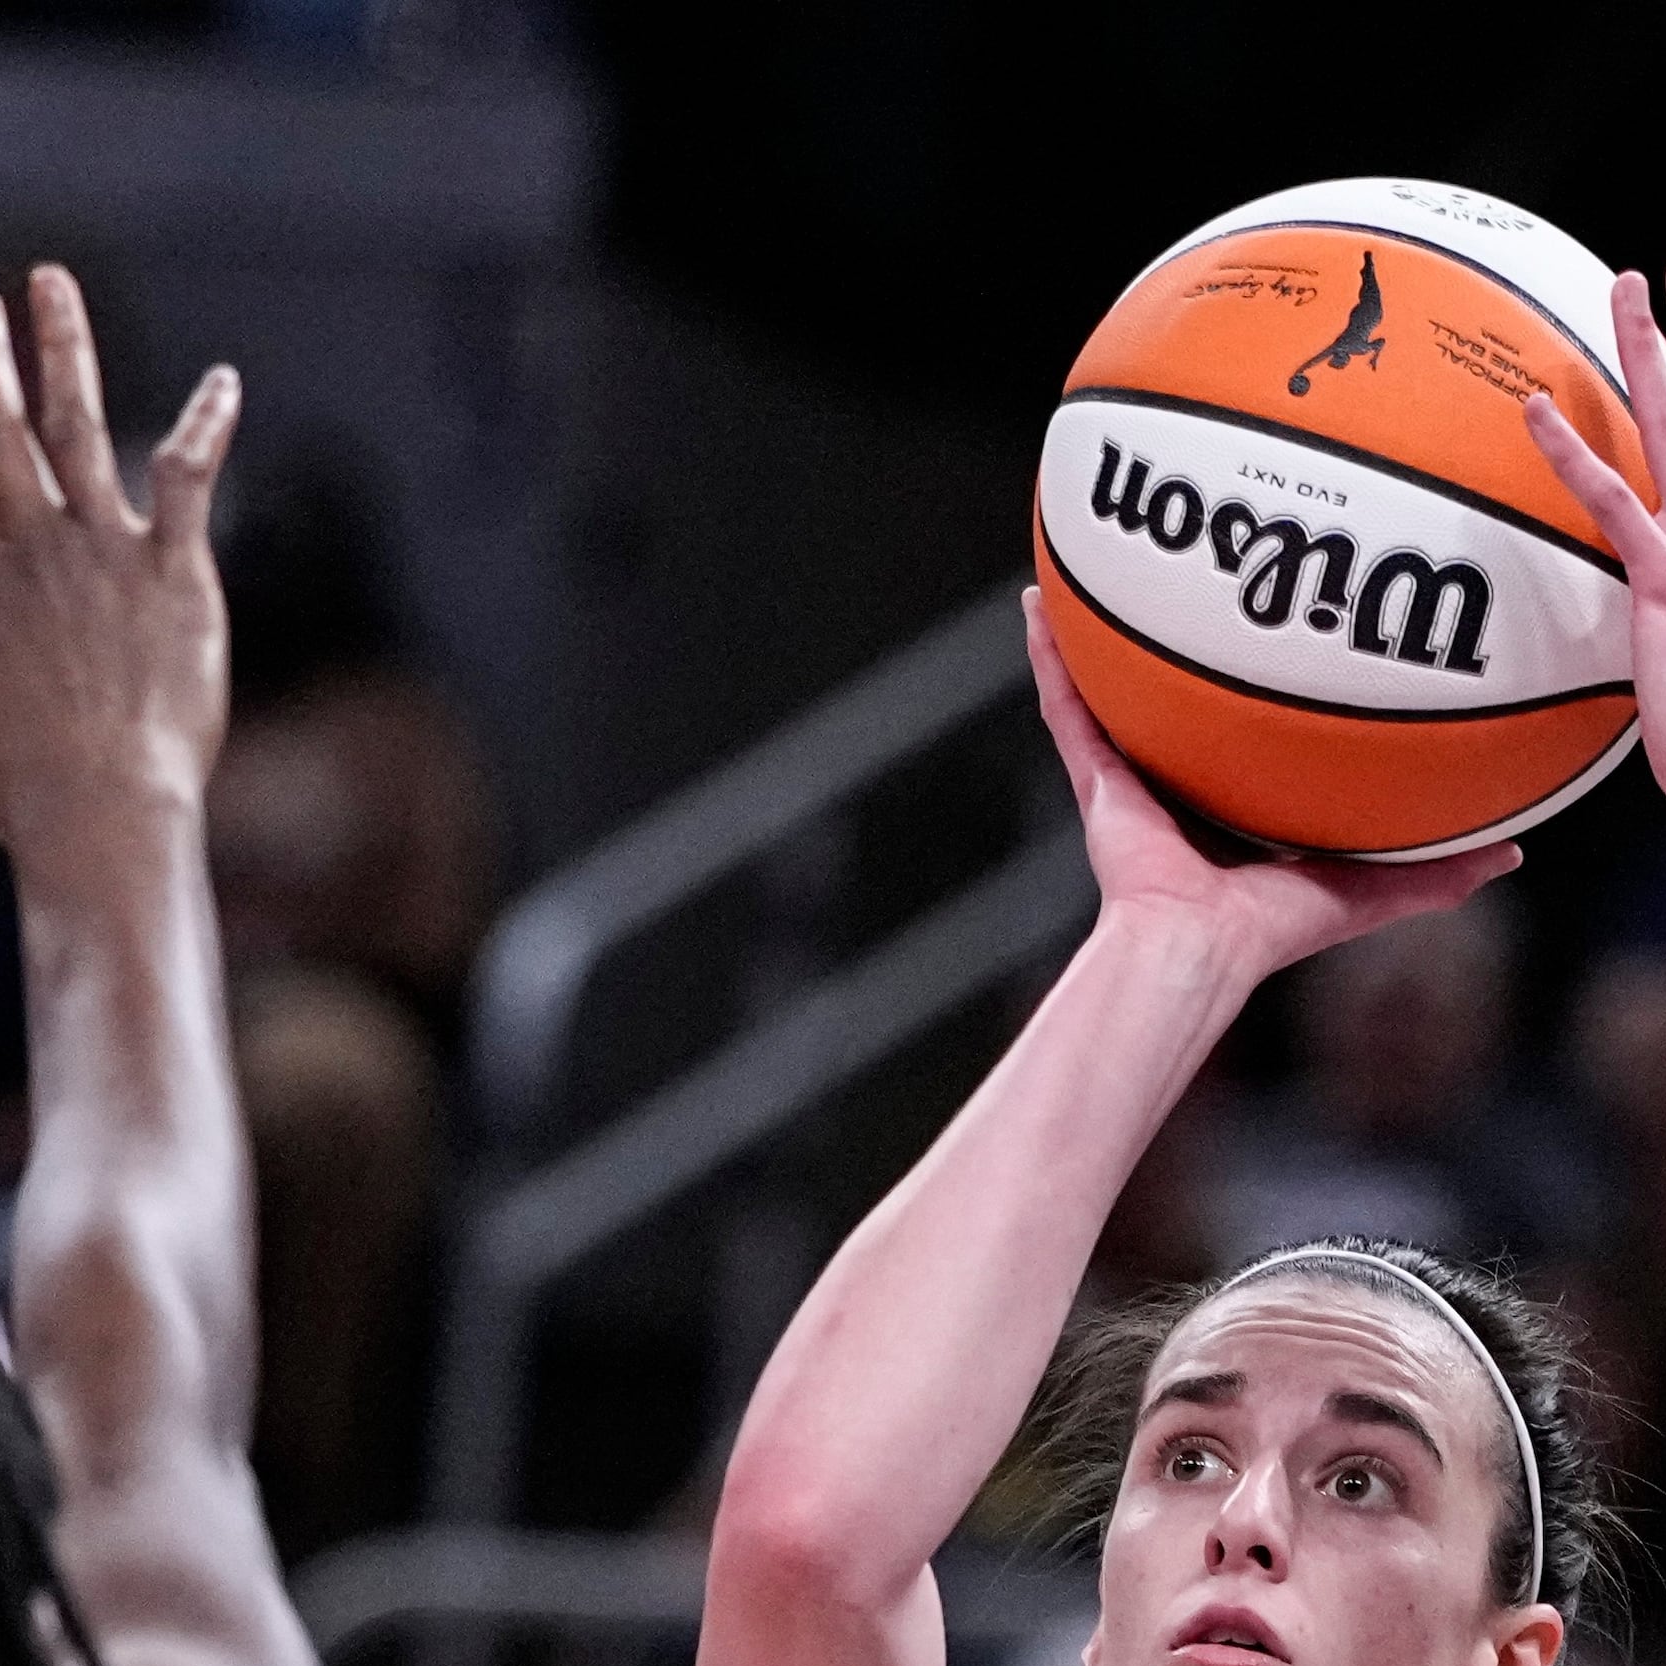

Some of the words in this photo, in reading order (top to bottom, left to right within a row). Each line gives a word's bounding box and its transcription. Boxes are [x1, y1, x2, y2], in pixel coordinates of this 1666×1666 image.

[1428, 319, 1486, 358] BALL
[1435, 341, 1530, 404] OFFICIAL
[1238, 464, 1286, 491] NXT
[1296, 482, 1348, 508] EVO
[1088, 437, 1494, 678] Wilson
